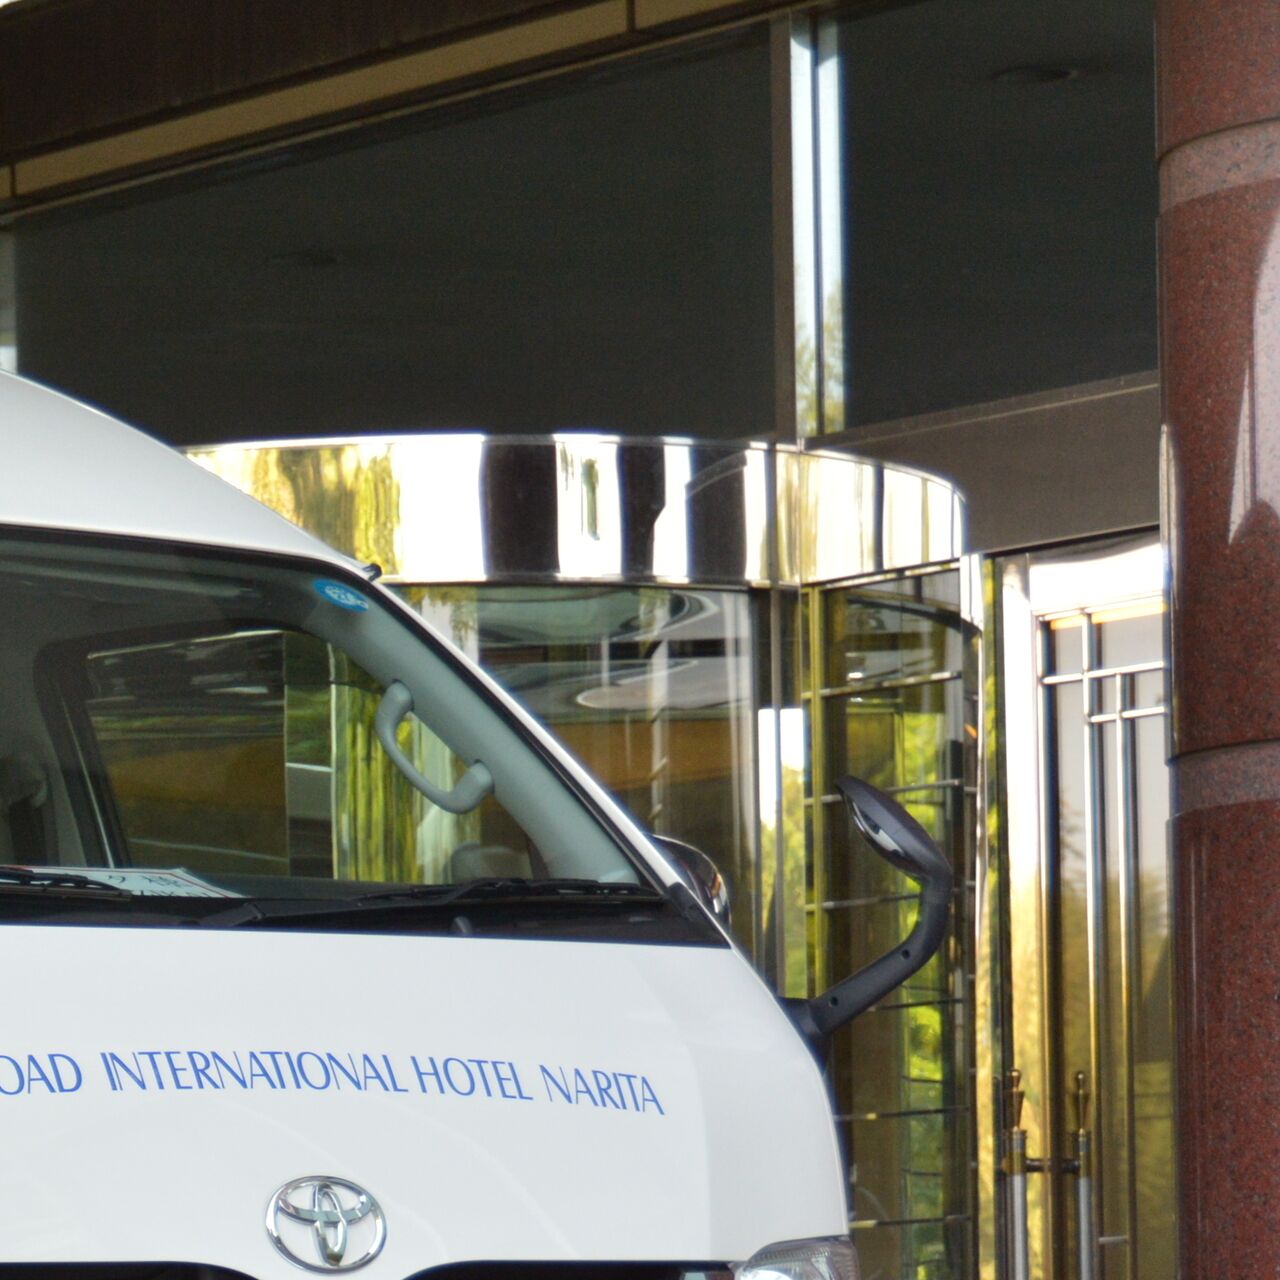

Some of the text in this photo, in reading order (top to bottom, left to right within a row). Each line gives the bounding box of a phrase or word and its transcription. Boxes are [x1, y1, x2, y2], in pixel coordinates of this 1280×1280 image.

[100, 1050, 408, 1094] INTERNATIONAL
[411, 1056, 534, 1101] HOTEL
[539, 1063, 665, 1116] NARITA
